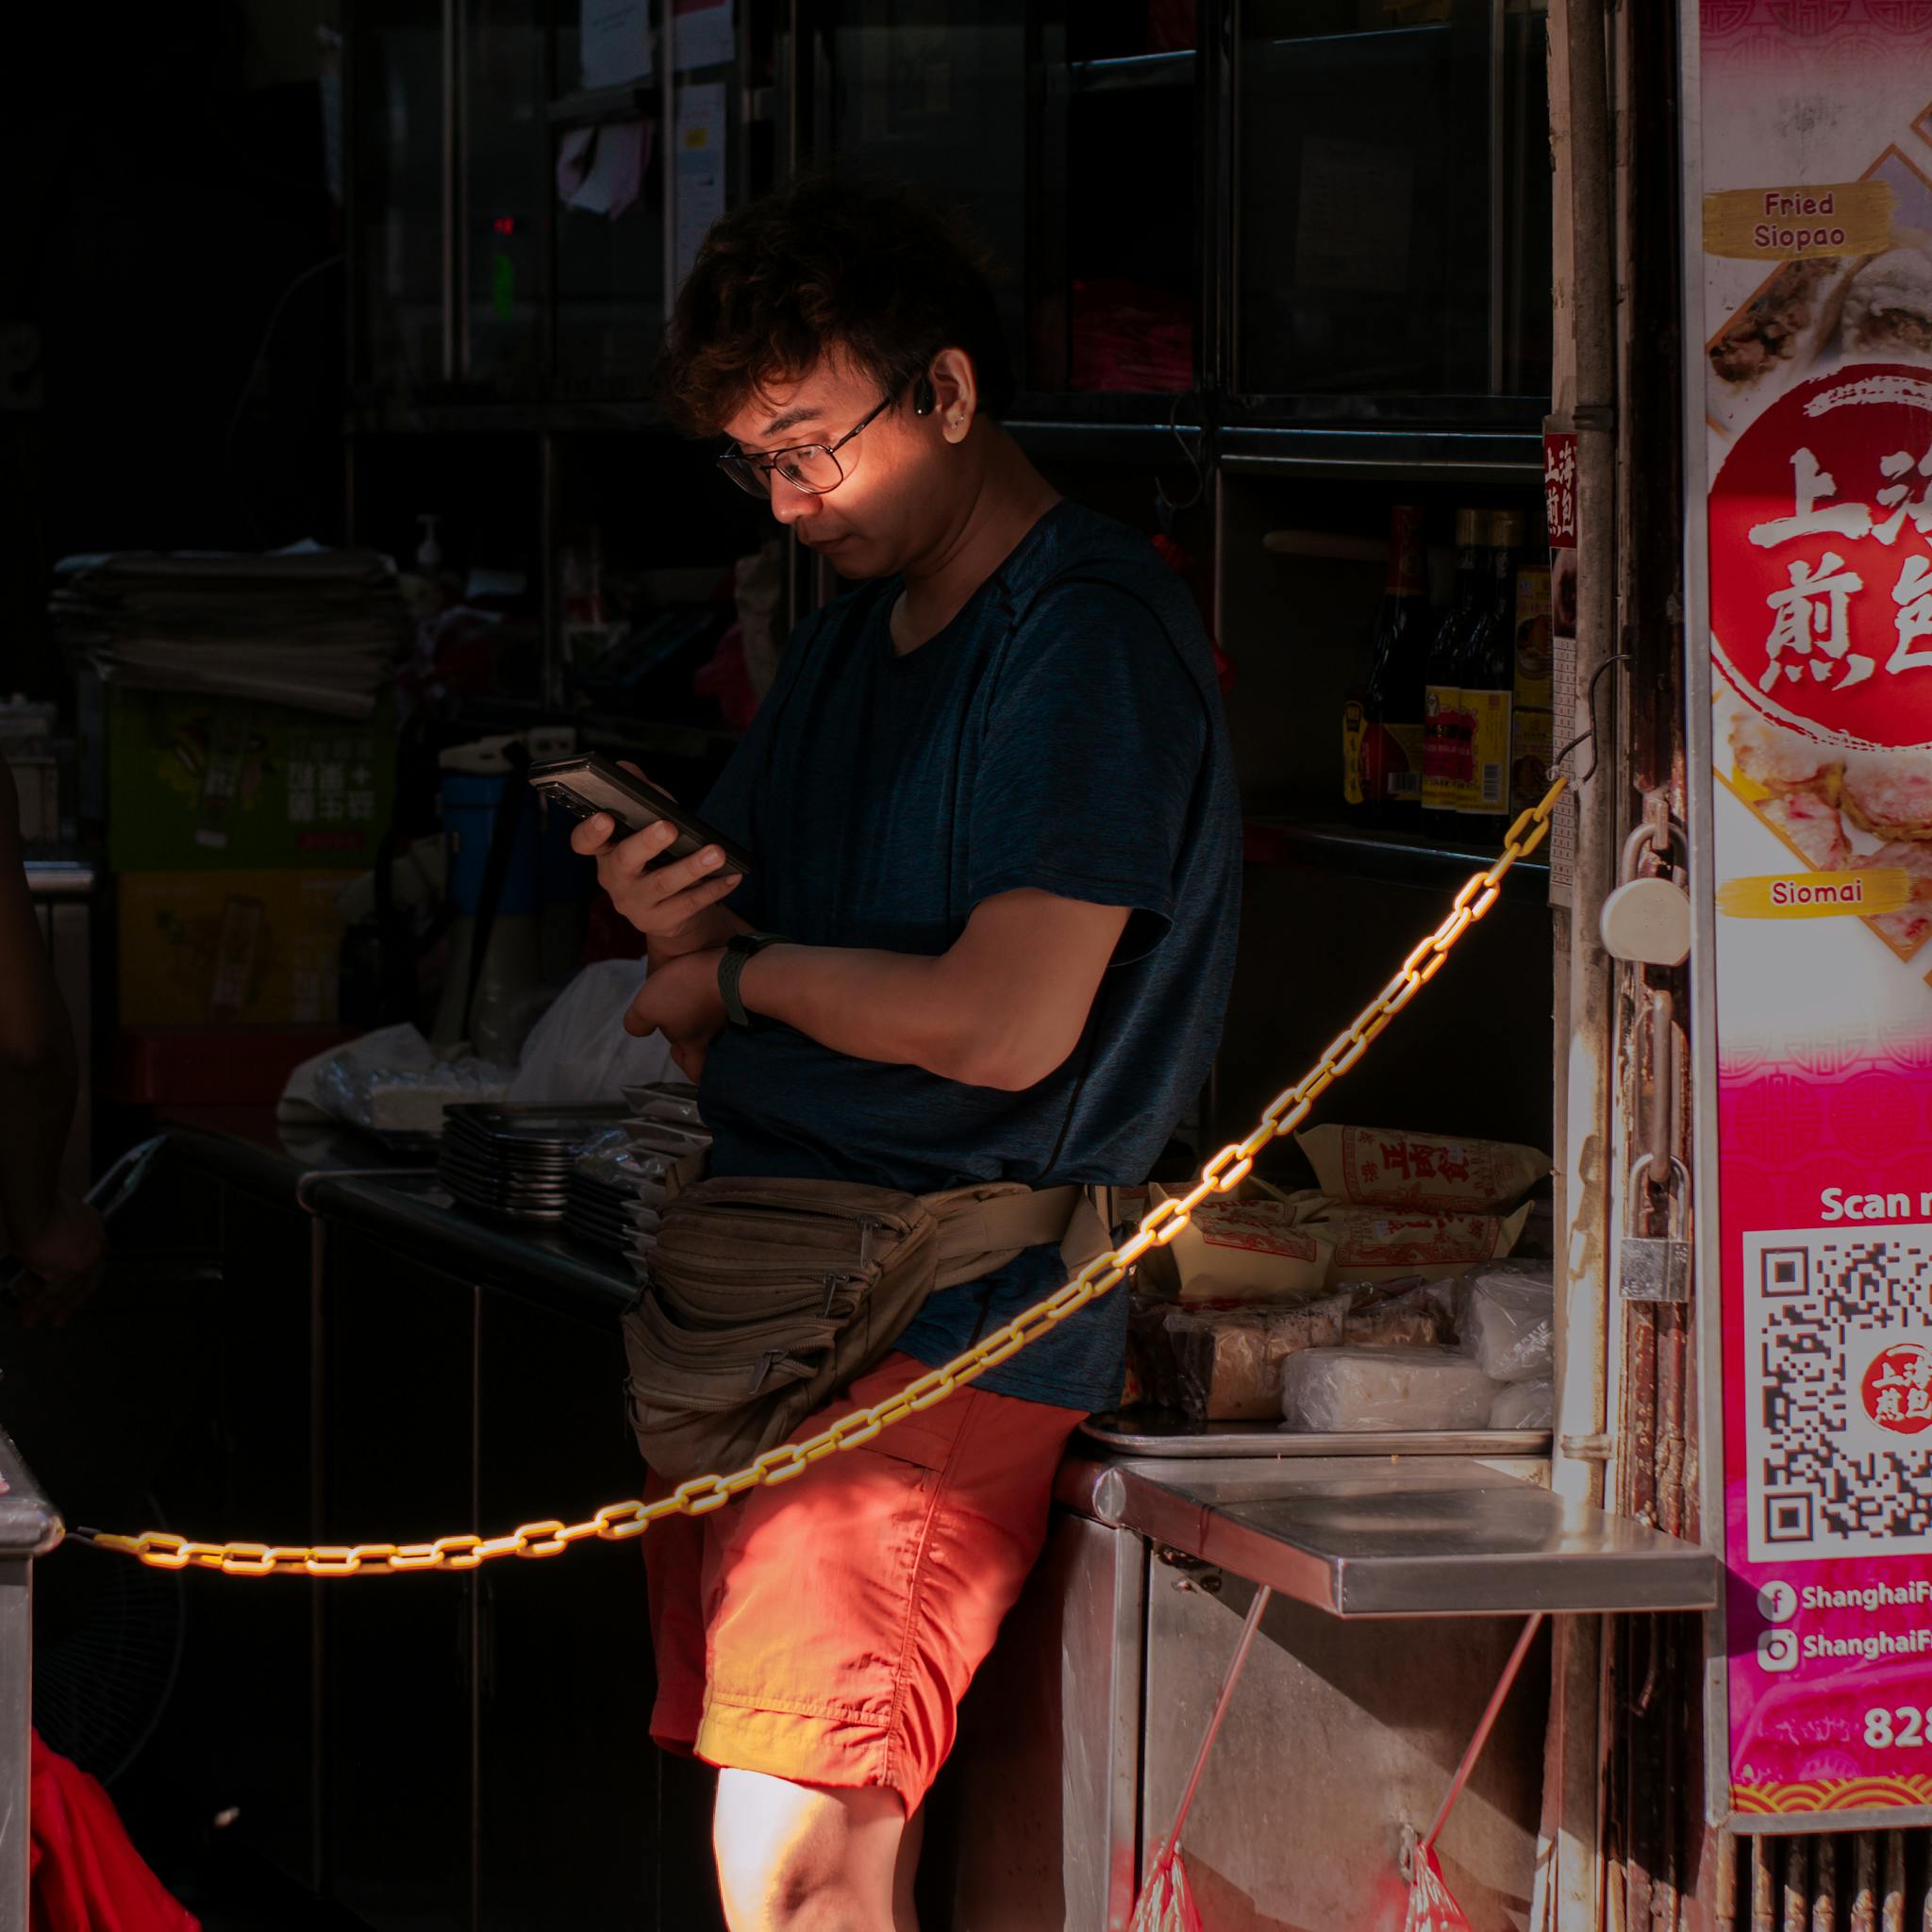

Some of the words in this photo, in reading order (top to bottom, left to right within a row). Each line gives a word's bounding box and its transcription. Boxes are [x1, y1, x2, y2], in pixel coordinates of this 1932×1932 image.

[1764, 192, 1834, 216] Fried
[1754, 225, 1845, 251] Siopao
[1773, 879, 1862, 905] Siomai
[1820, 1187, 1911, 1222] Scan
[1801, 1580, 1932, 1612] ShanghaiF
[1803, 1629, 1932, 1661] ShanghaiF
[1863, 1706, 1932, 1749] 82
